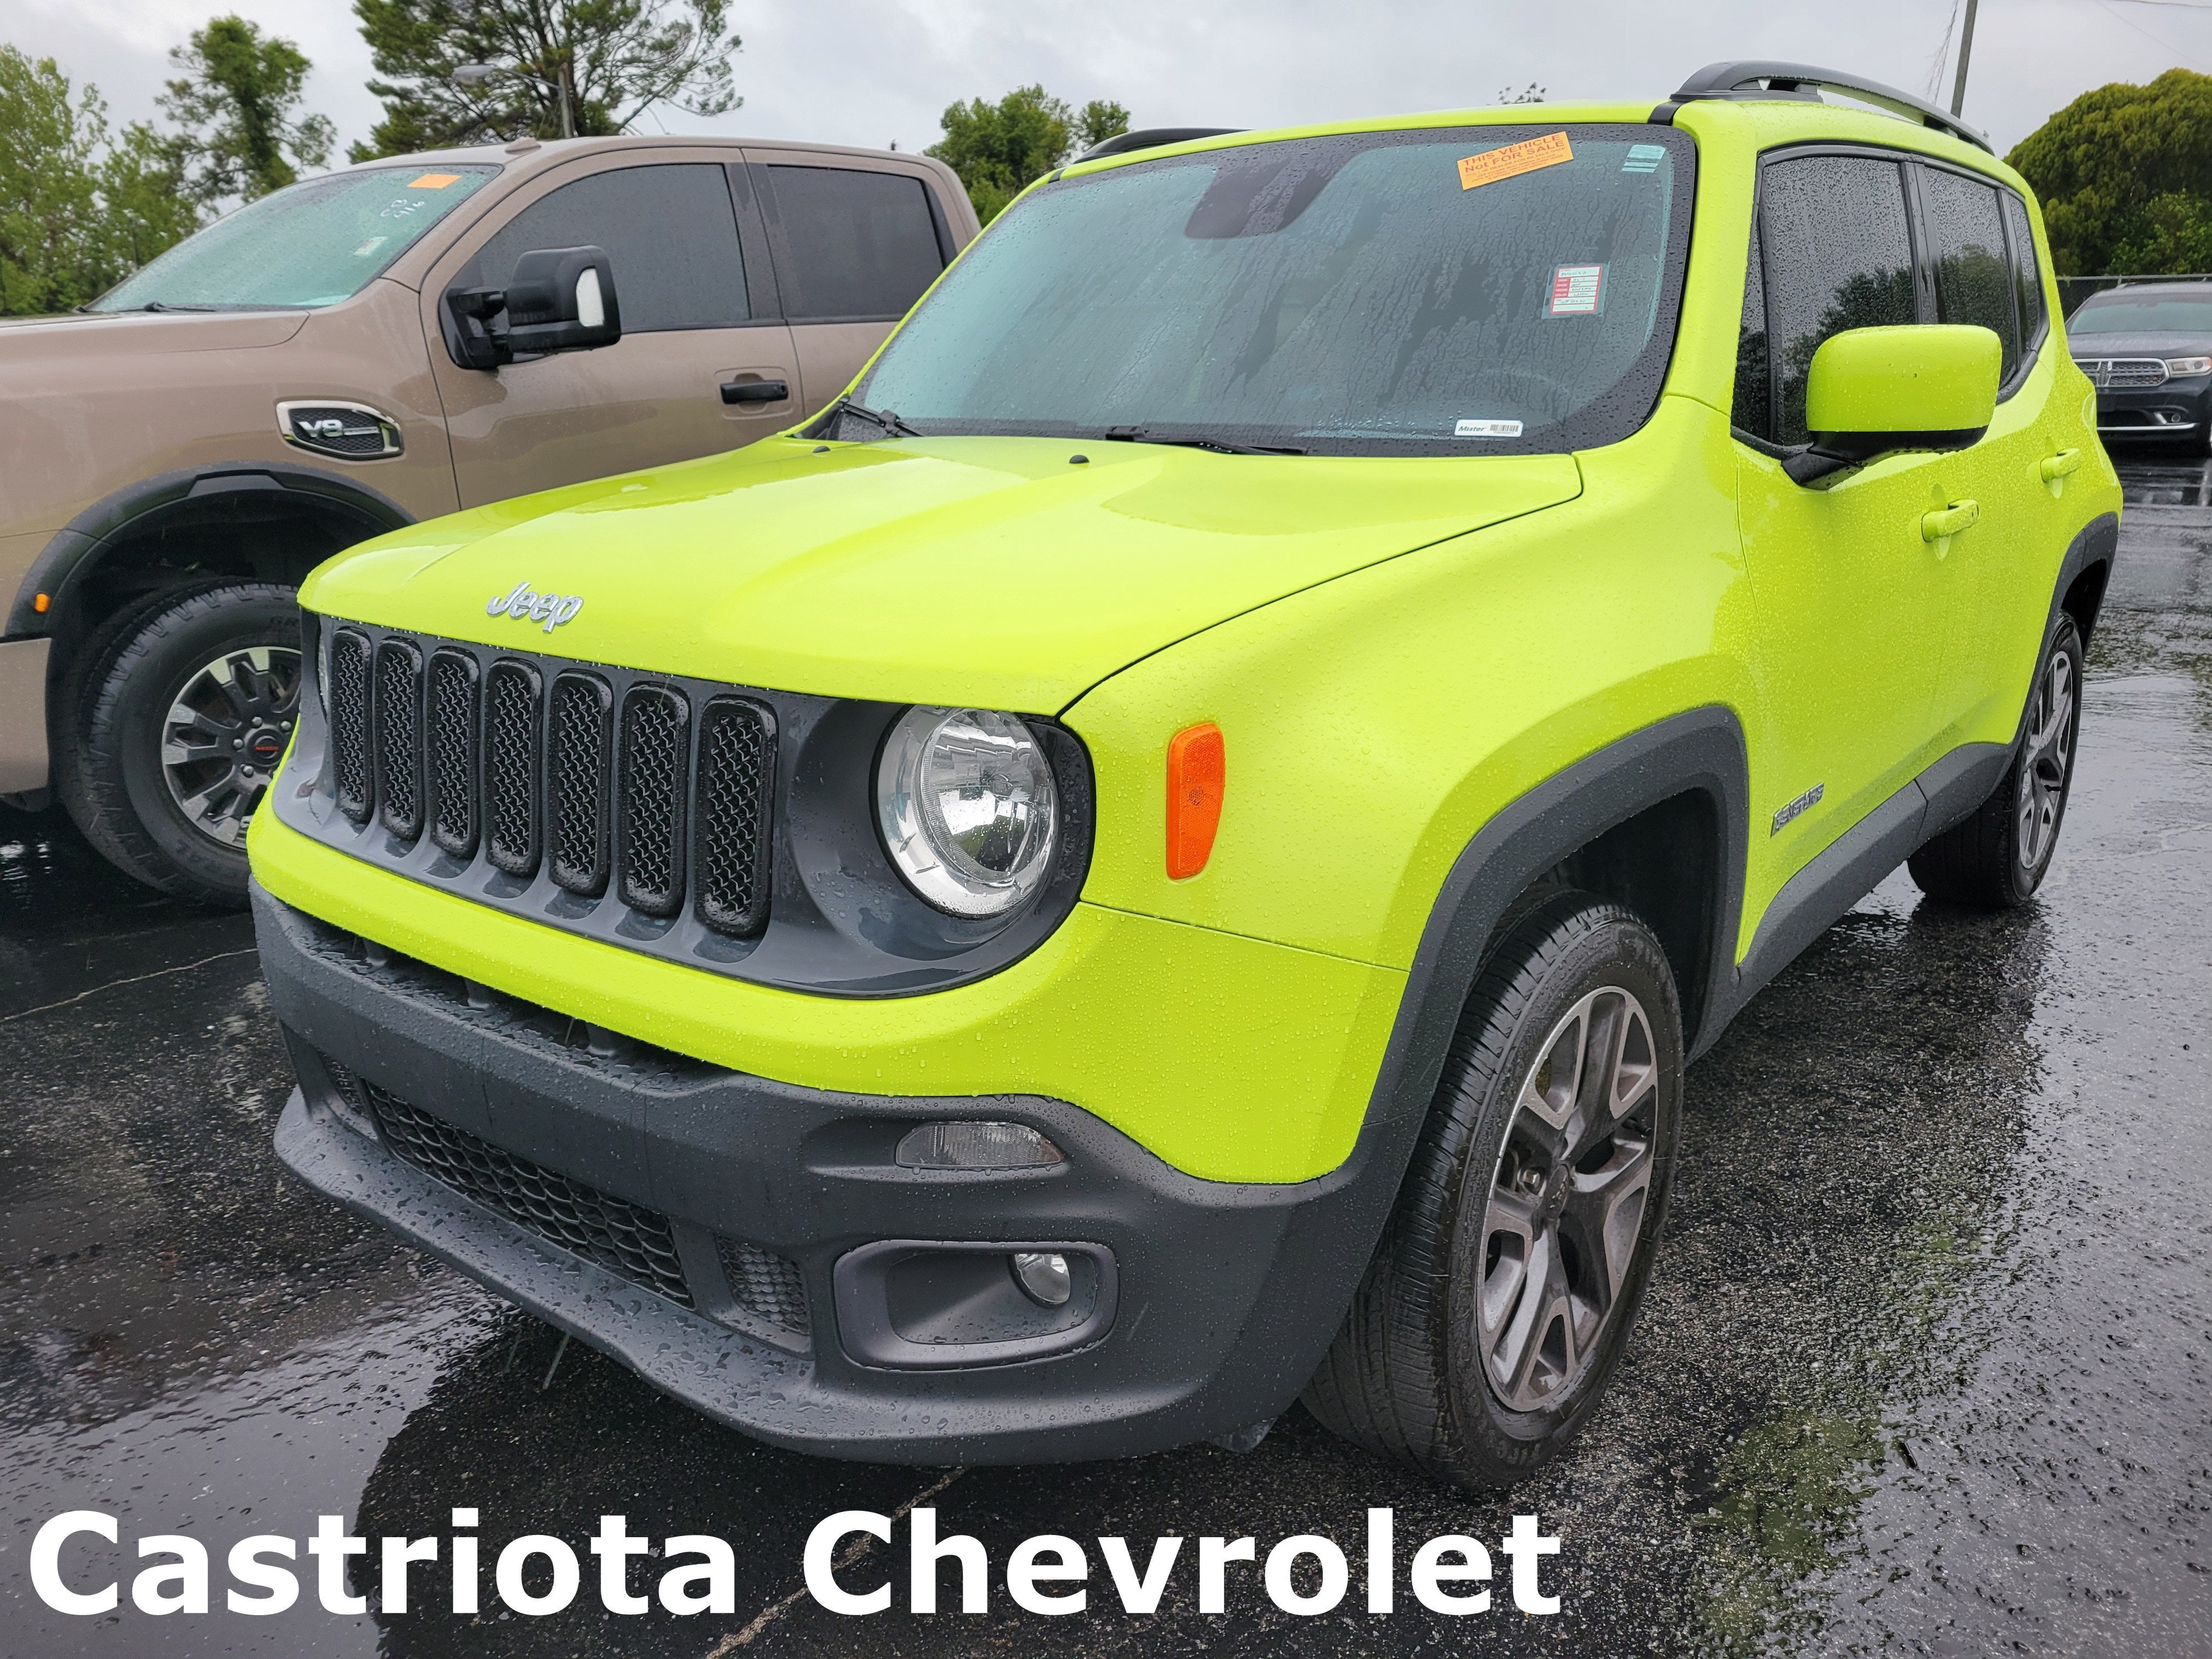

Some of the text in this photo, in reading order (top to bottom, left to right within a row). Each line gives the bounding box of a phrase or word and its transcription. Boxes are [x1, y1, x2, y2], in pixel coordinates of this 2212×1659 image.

[1463, 134, 1562, 166] THIS VEHICLE
[1465, 162, 1488, 173] Not
[1492, 153, 1522, 165] FOR
[1527, 140, 1565, 155] SALE
[298, 419, 345, 438] V8
[1458, 425, 1486, 433] Mister
[486, 582, 584, 634] Jeep
